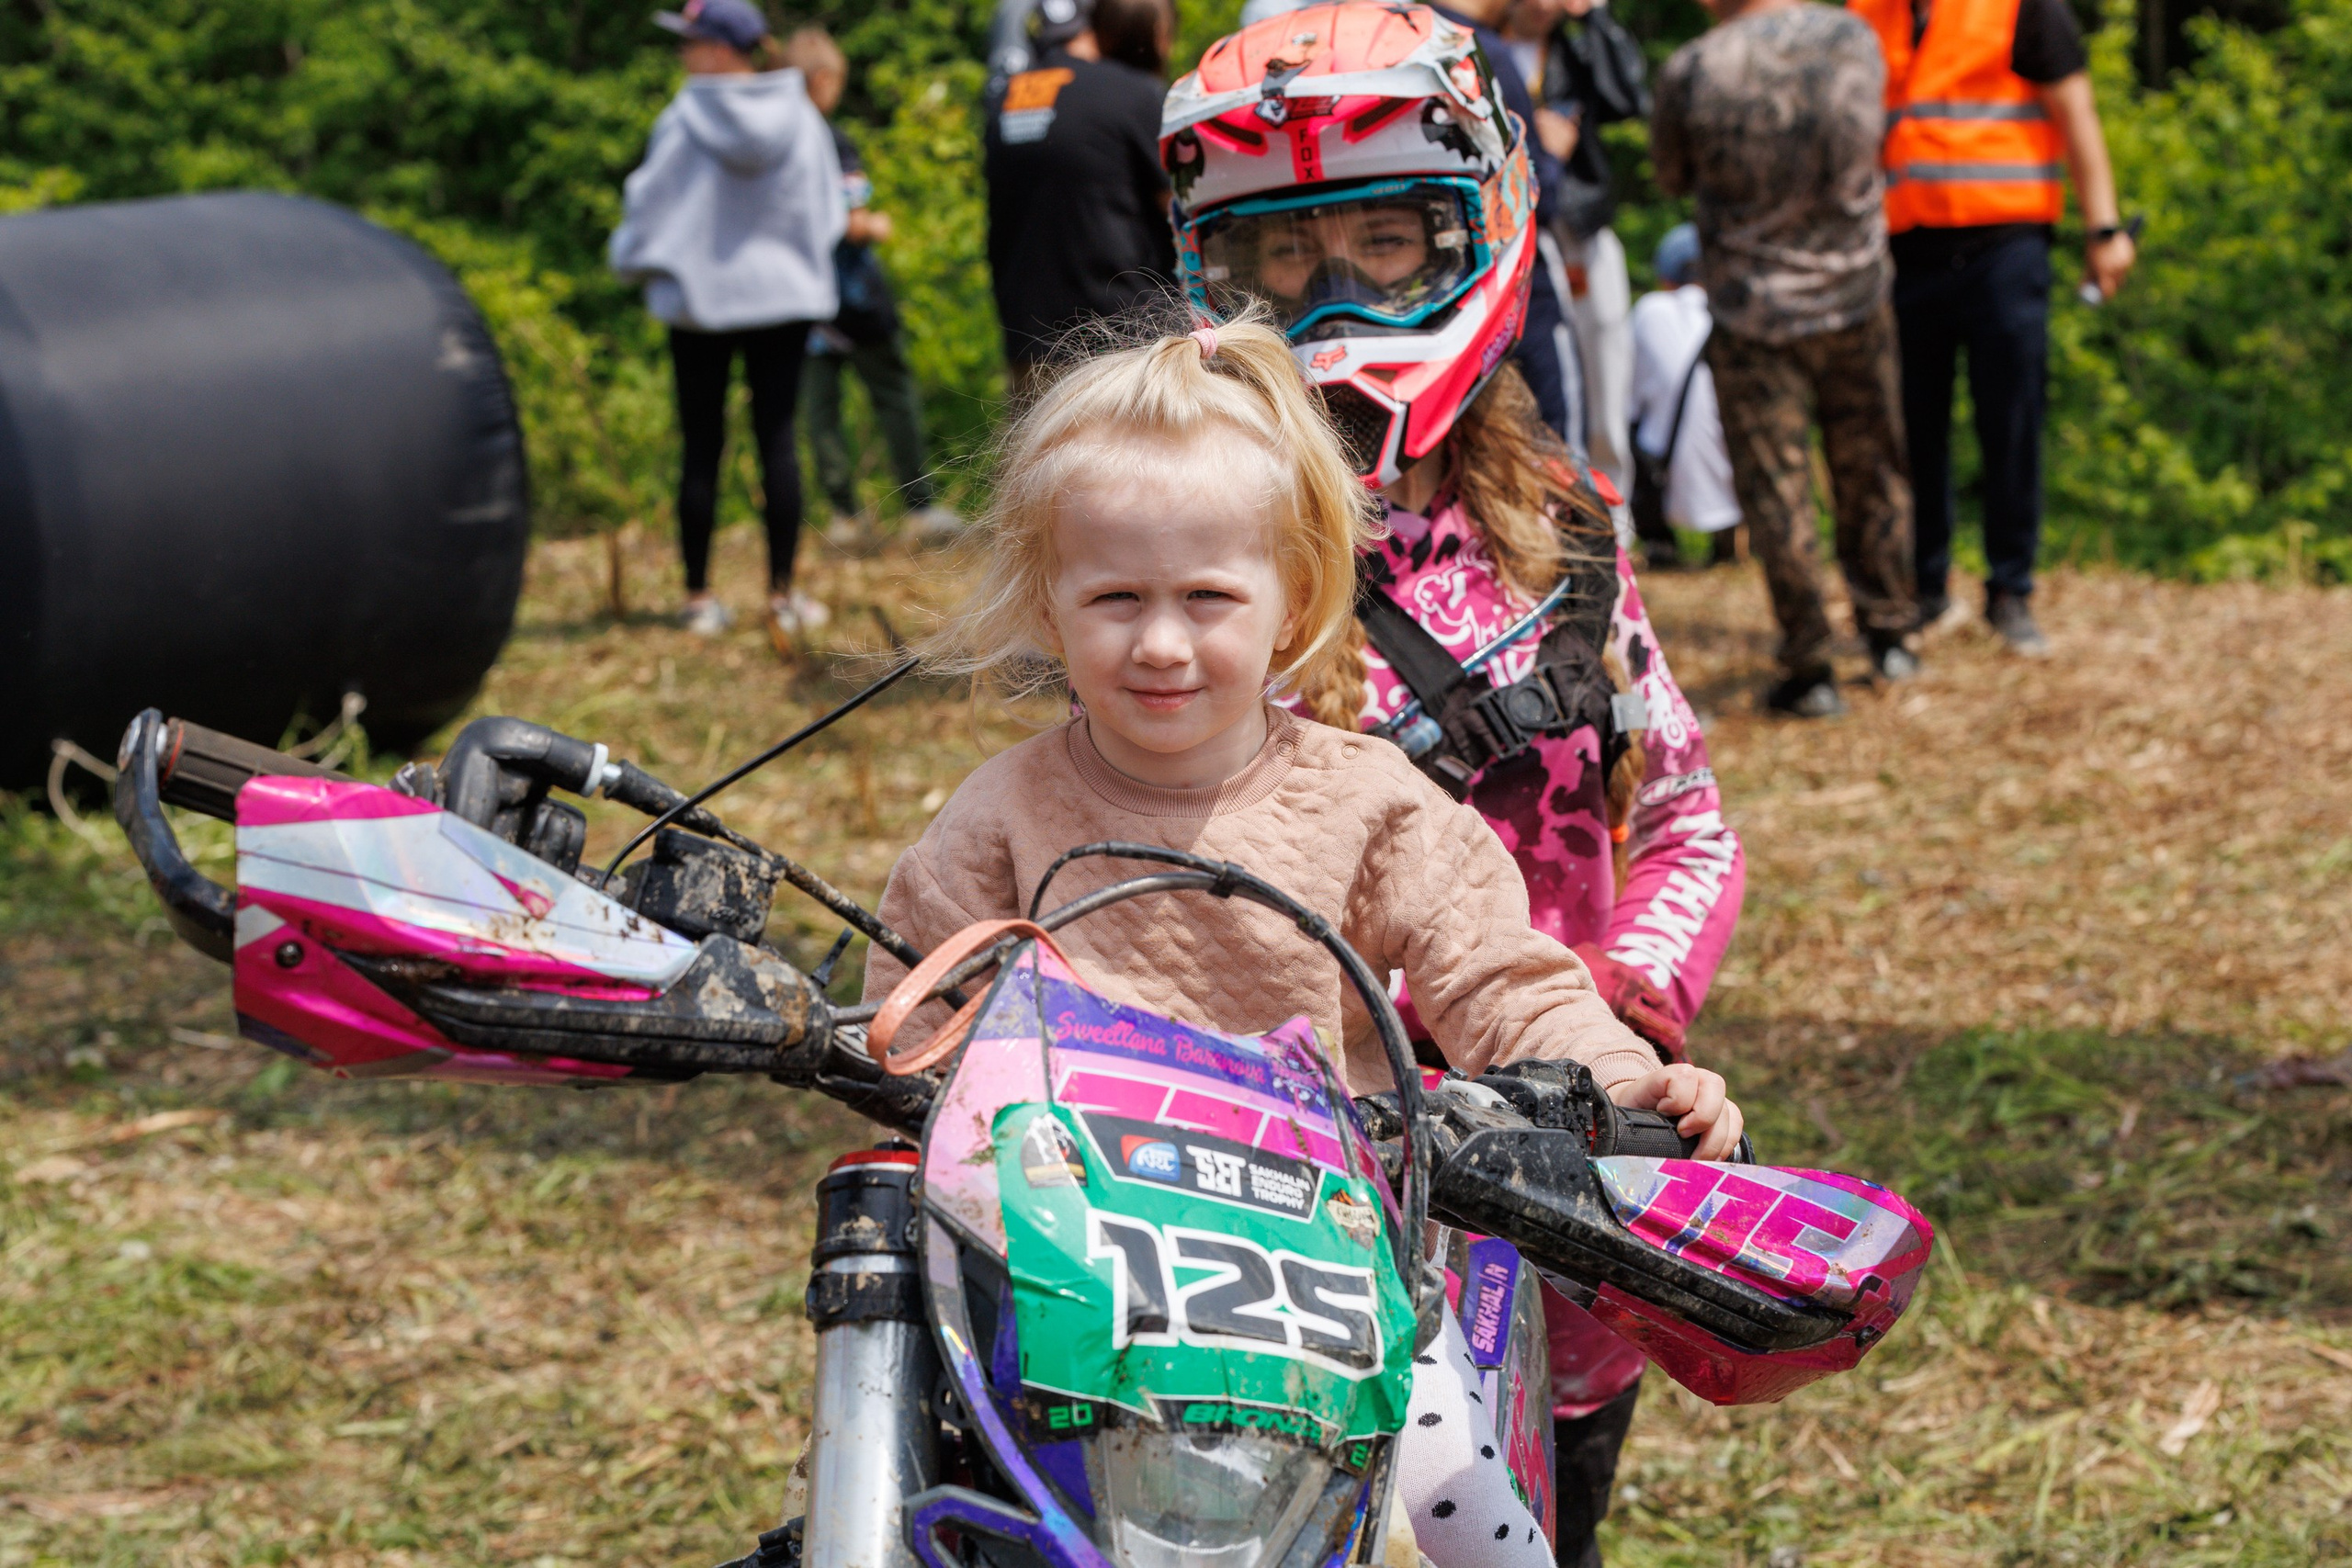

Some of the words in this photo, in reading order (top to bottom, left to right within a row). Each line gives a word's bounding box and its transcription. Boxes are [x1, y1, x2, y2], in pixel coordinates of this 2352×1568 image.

[1299, 129, 1315, 180] FOX
[1248, 1162, 1312, 1192] SAKHALIN
[1251, 1175, 1305, 1200] ENDURO
[1251, 1186, 1306, 1211] TROPHY
[1086, 1207, 1385, 1382] 125
[1047, 1403, 1093, 1430] 20
